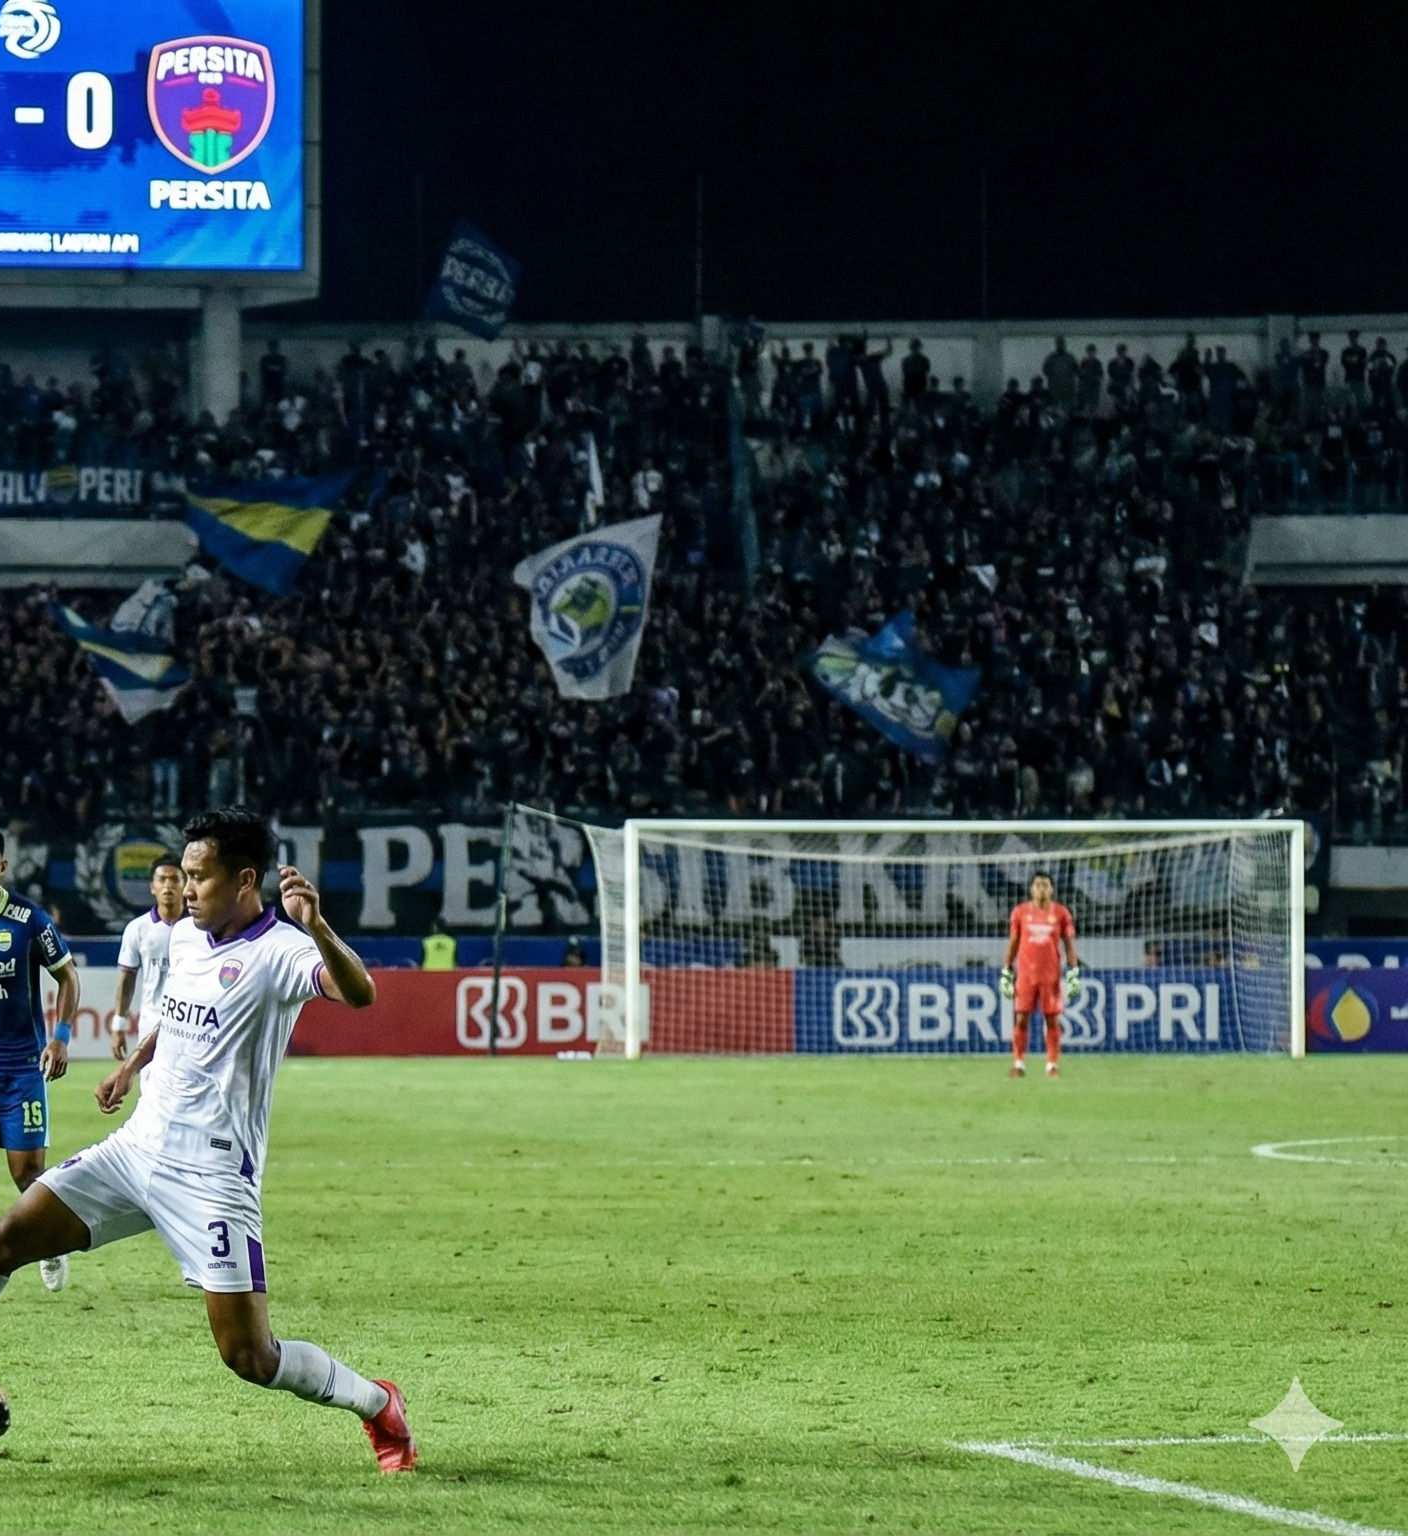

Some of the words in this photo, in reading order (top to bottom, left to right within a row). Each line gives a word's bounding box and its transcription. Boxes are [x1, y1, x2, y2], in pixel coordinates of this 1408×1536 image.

[156, 46, 264, 83] PERSITA
[67, 71, 113, 150] 0
[150, 179, 271, 210] PERSITA
[1115, 983, 1220, 1042] PRI
[208, 1221, 231, 1257] 3
